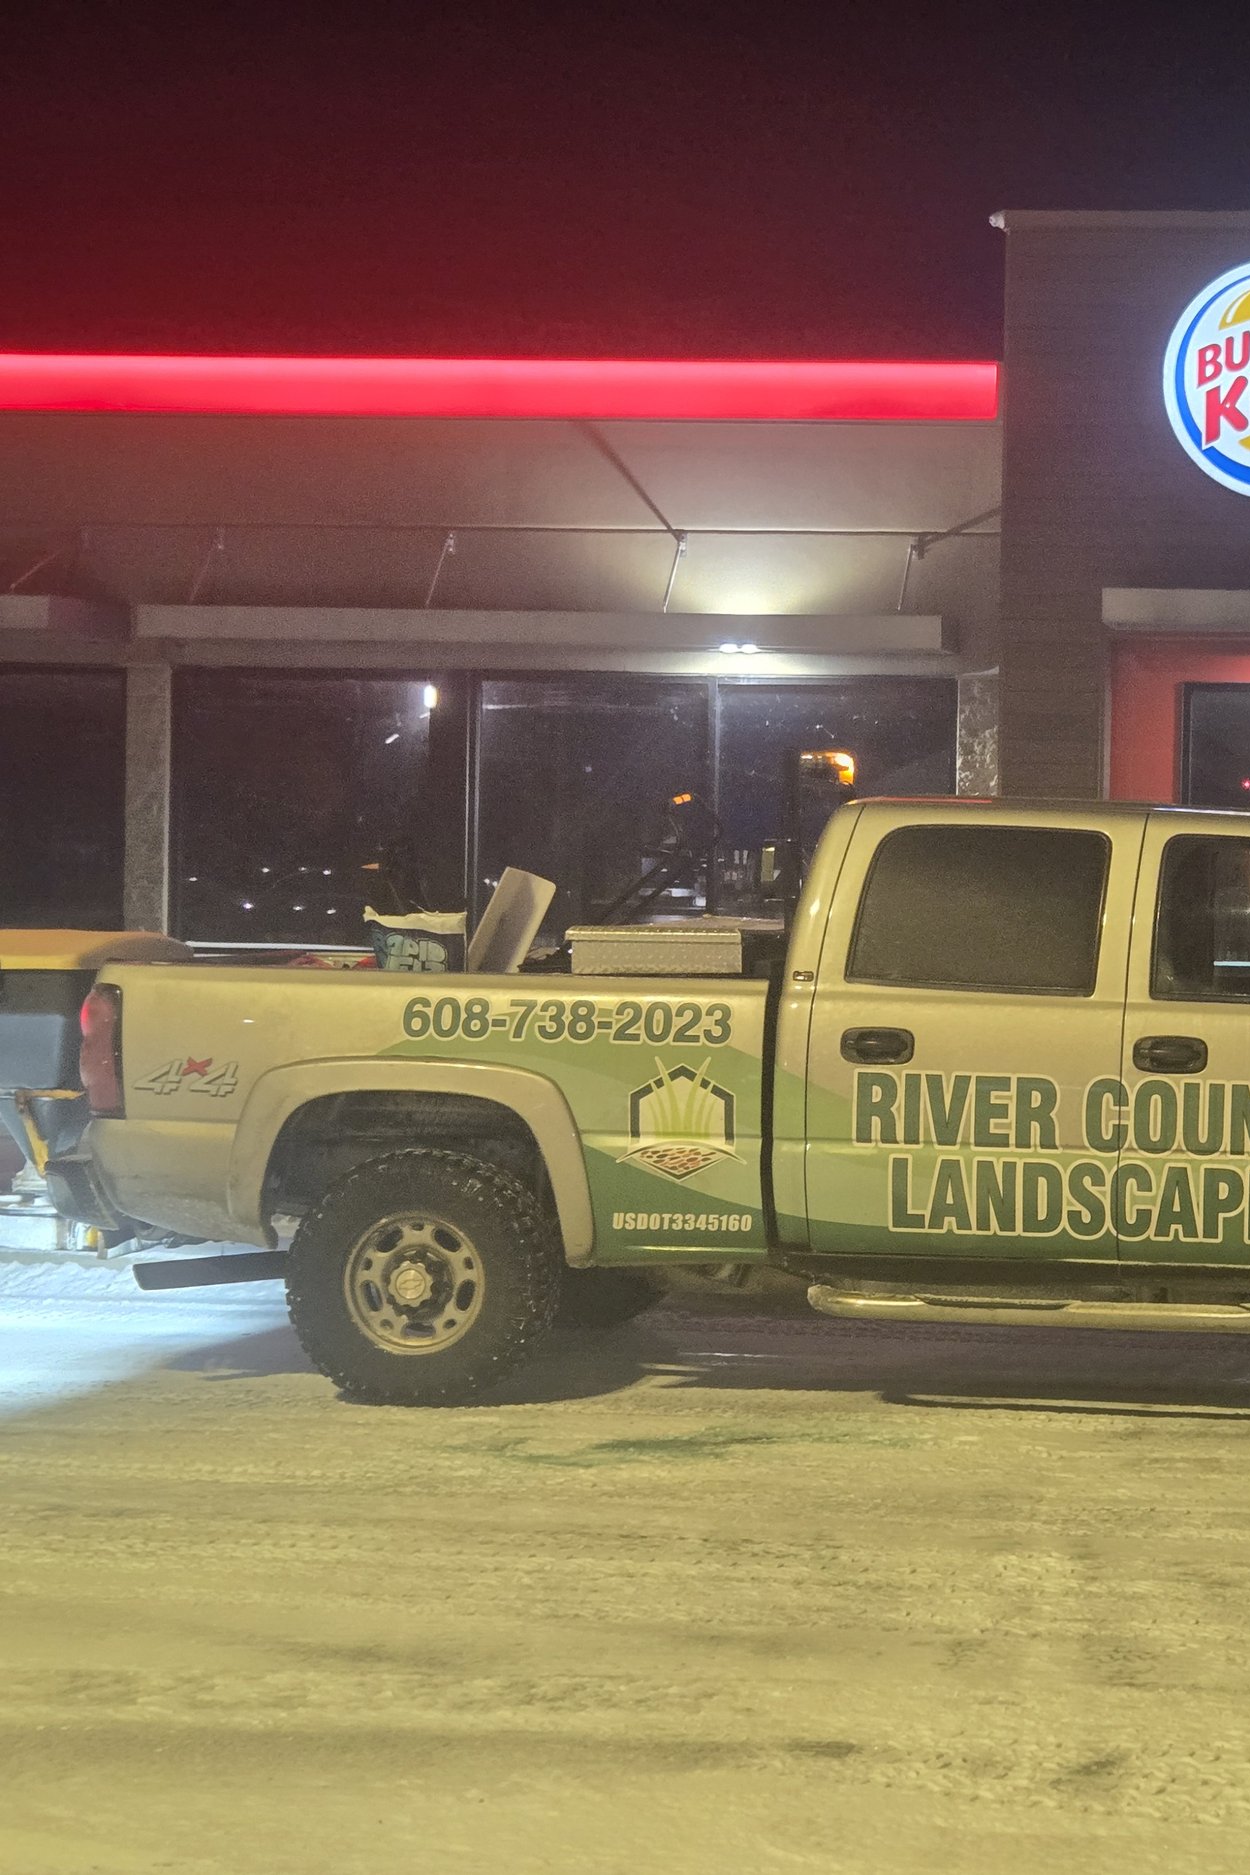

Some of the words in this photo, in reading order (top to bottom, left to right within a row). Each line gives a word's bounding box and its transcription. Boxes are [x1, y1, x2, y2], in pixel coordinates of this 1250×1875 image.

[402, 996, 732, 1046] 608-738-2023
[853, 1069, 1061, 1152] RIVER
[612, 1212, 752, 1232] USDOT3345160
